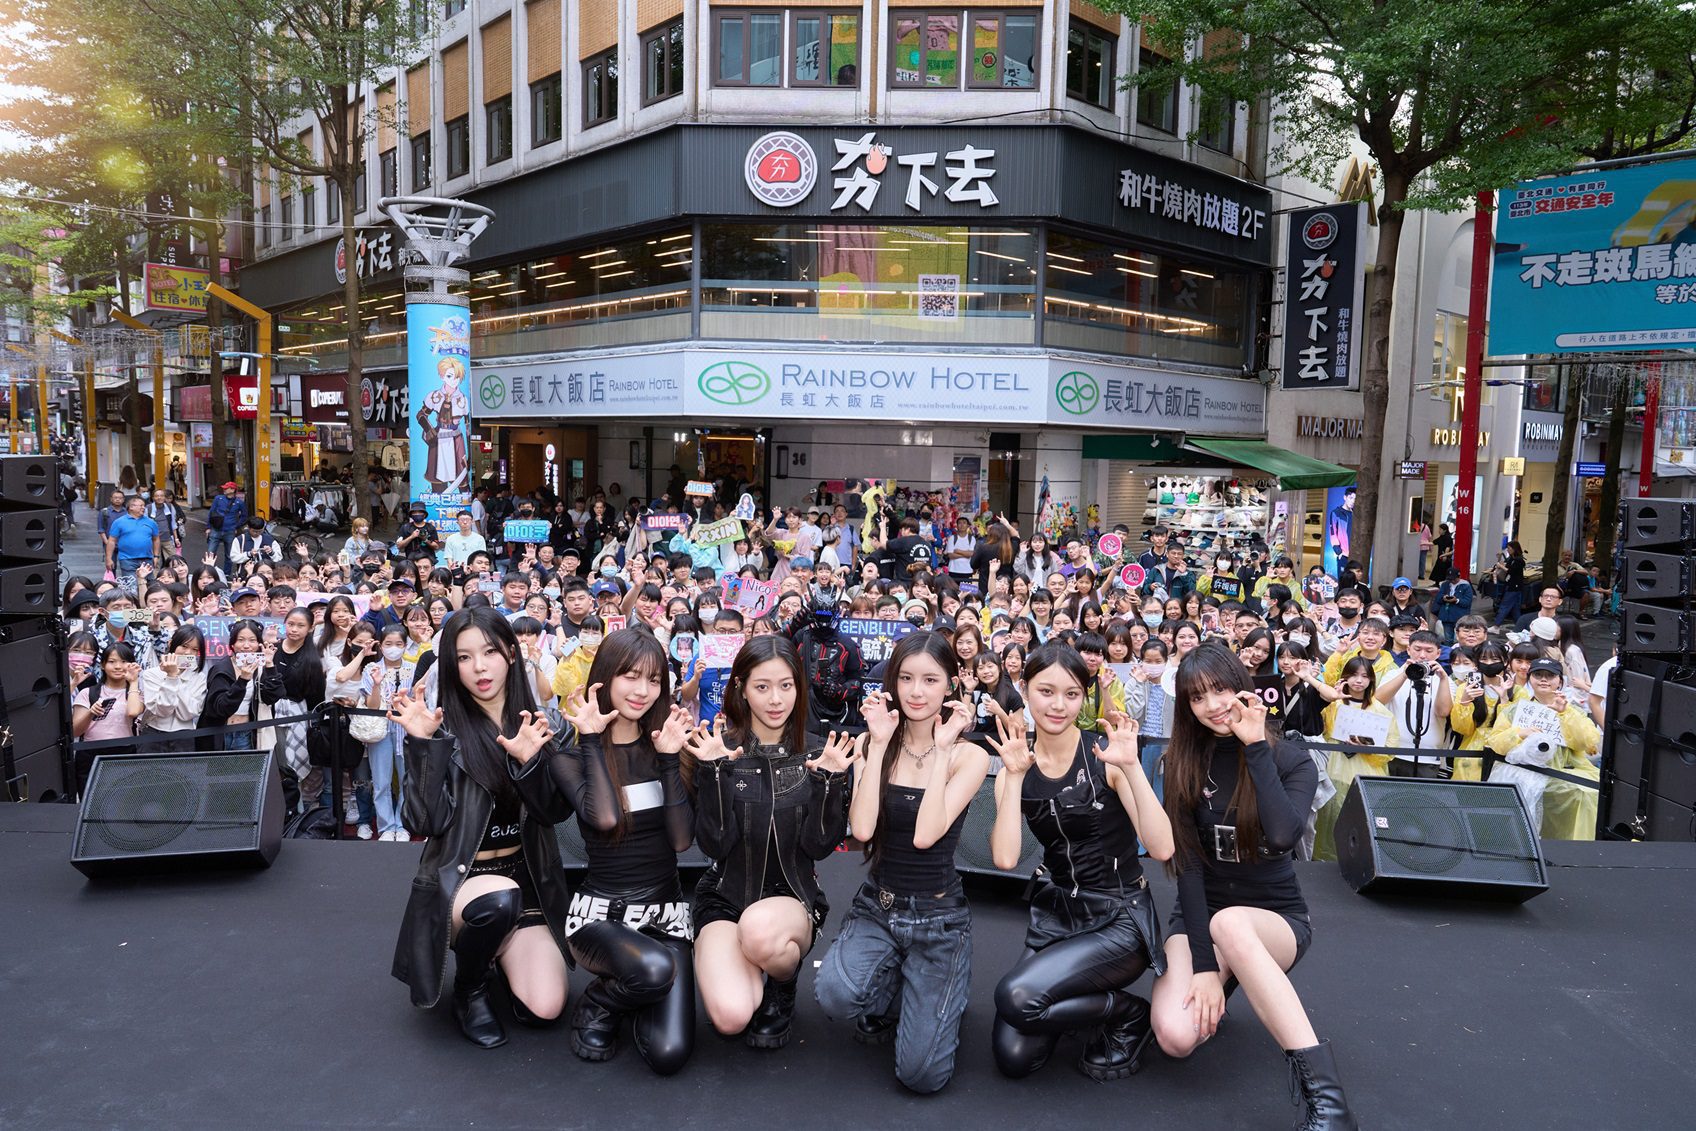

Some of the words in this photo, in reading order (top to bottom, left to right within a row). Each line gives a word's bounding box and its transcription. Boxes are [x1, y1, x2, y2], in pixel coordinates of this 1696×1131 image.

[830, 132, 1000, 212] 夯下去
[1119, 169, 1266, 241] 和牛燒肉放題2F
[1534, 192, 1615, 214] 交通安全年
[1298, 253, 1338, 381] 夯下去
[511, 371, 605, 406] 長虹大飯店
[779, 391, 886, 409] 長虹大飯店
[1104, 379, 1201, 419] 長虹大飯店
[1302, 416, 1345, 438] MAJOR
[1524, 422, 1564, 441] ROBINMAY
[1434, 428, 1491, 447] ROBIAY
[1401, 461, 1424, 469] MAJOR
[1459, 489, 1470, 498] W
[1458, 506, 1470, 515] 16
[839, 620, 902, 636] GENBLU
